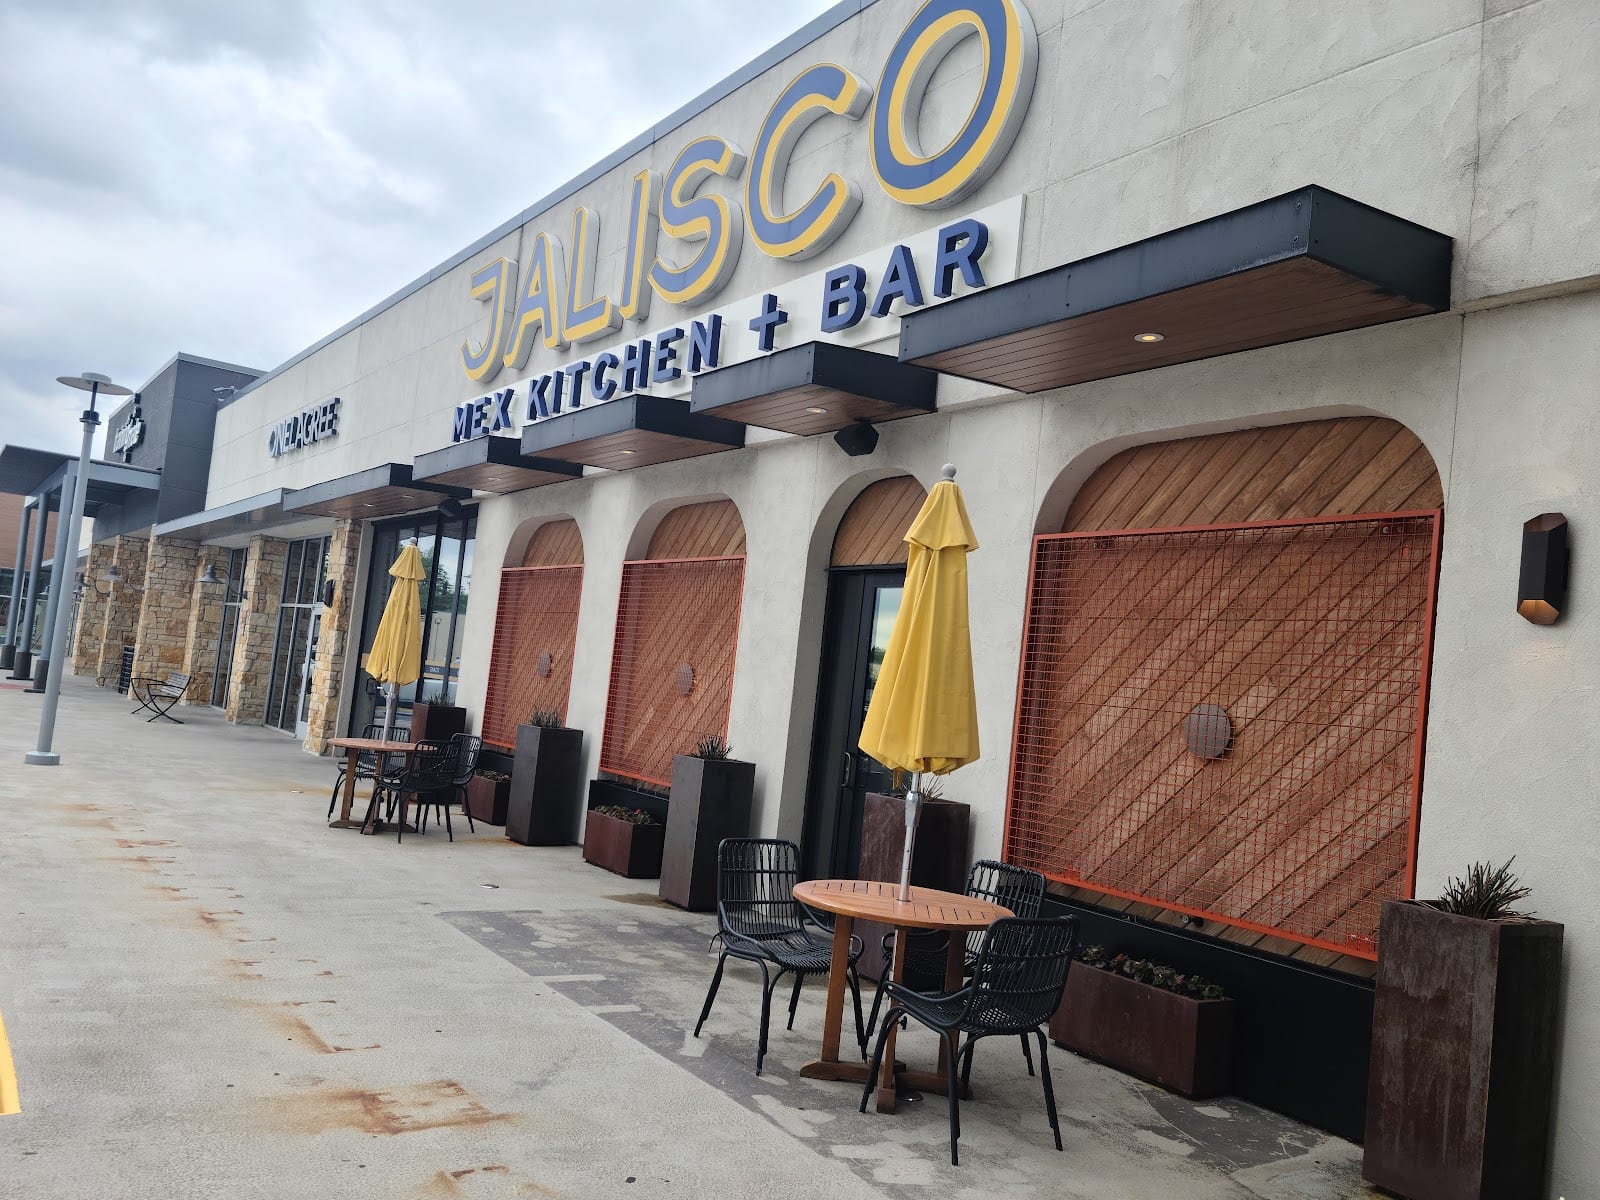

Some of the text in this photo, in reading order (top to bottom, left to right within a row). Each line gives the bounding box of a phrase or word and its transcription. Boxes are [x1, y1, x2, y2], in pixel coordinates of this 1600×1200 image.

[451, 218, 989, 443] MEX KITCHEN + BAR
[461, 0, 1039, 384] JALISCO
